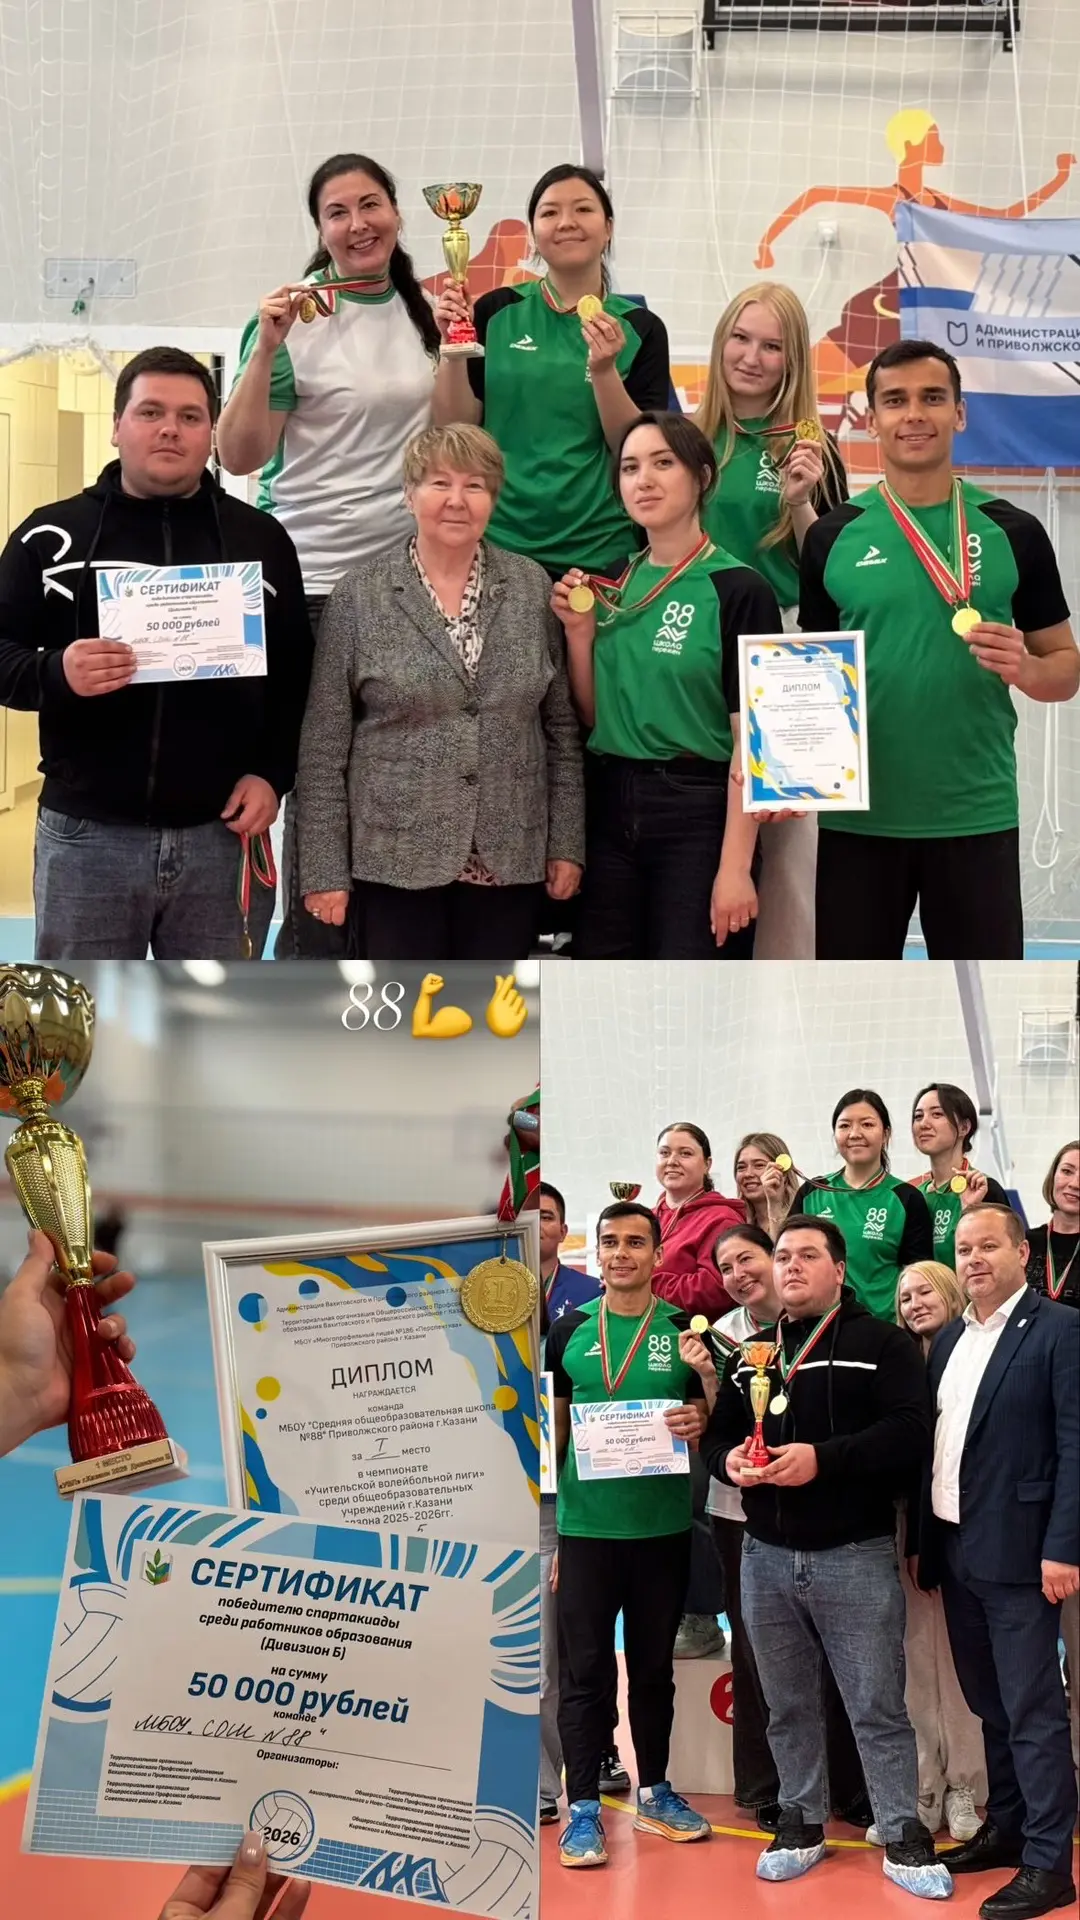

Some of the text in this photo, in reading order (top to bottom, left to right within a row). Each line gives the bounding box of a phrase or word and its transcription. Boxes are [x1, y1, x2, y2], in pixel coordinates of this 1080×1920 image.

[976, 338, 1080, 352] И ПРИВОЛЖСКО
[140, 581, 221, 596] СЕРТИФИКАТ
[662, 601, 695, 627] 88
[146, 617, 220, 631] 50 000 рублей
[782, 683, 821, 693] ДИПЛОМ
[866, 1207, 887, 1223] 88
[935, 1209, 951, 1226] 88
[276, 1302, 324, 1312] Администрация
[325, 1298, 367, 1308] Вахитовского
[281, 1315, 335, 1326] Территориальная
[336, 1311, 375, 1320] организация
[282, 1323, 322, 1333] образования
[323, 1319, 365, 1328] Вахитовского
[294, 1337, 311, 1345] МБОУ
[376, 1329, 394, 1337] лицей
[331, 1338, 375, 1348] Приволжского
[376, 1336, 398, 1344] района
[648, 1335, 671, 1352] 88
[331, 1358, 434, 1390] ДИПЛОМ
[353, 1385, 417, 1399] НАГРАЖДАЕТСЯ
[368, 1403, 404, 1413] команда
[279, 1422, 305, 1433] МБОУ
[354, 1406, 464, 1425] общеобразовательная
[465, 1402, 497, 1413] школа
[600, 1411, 654, 1422] СЕРТИФИКАТ
[329, 1424, 398, 1439] Приволжского
[399, 1420, 434, 1432] района
[436, 1415, 478, 1428] г.Казани
[616, 1437, 630, 1445] 000
[351, 1453, 362, 1461] за
[401, 1446, 431, 1456] место
[357, 1463, 429, 1479] в чемпионате
[304, 1470, 485, 1495] «Учительской волейбольной лиги»
[319, 1483, 474, 1508] среди общеобразовательных
[341, 1497, 453, 1518] учреждений г.Казани
[190, 1558, 429, 1612] СЕРТИФИКАТ
[217, 1596, 400, 1629] победителю спартакиады
[199, 1612, 412, 1650] среди работников образования
[260, 1636, 346, 1660] (Дивизион Б)
[270, 1664, 327, 1683] на сумму
[187, 1671, 410, 1724] 50 000 рублей
[273, 1708, 317, 1724] команде
[108, 1761, 157, 1771] Общероссийского
[110, 1754, 158, 1763] Территориальная
[256, 1748, 339, 1769] Организаторы:
[354, 1789, 403, 1803] Общероссийского
[388, 1787, 437, 1801] Территориальная
[351, 1815, 401, 1829] Общероссийского
[385, 1814, 434, 1828] Территориальная
[263, 1826, 301, 1846] 2026
